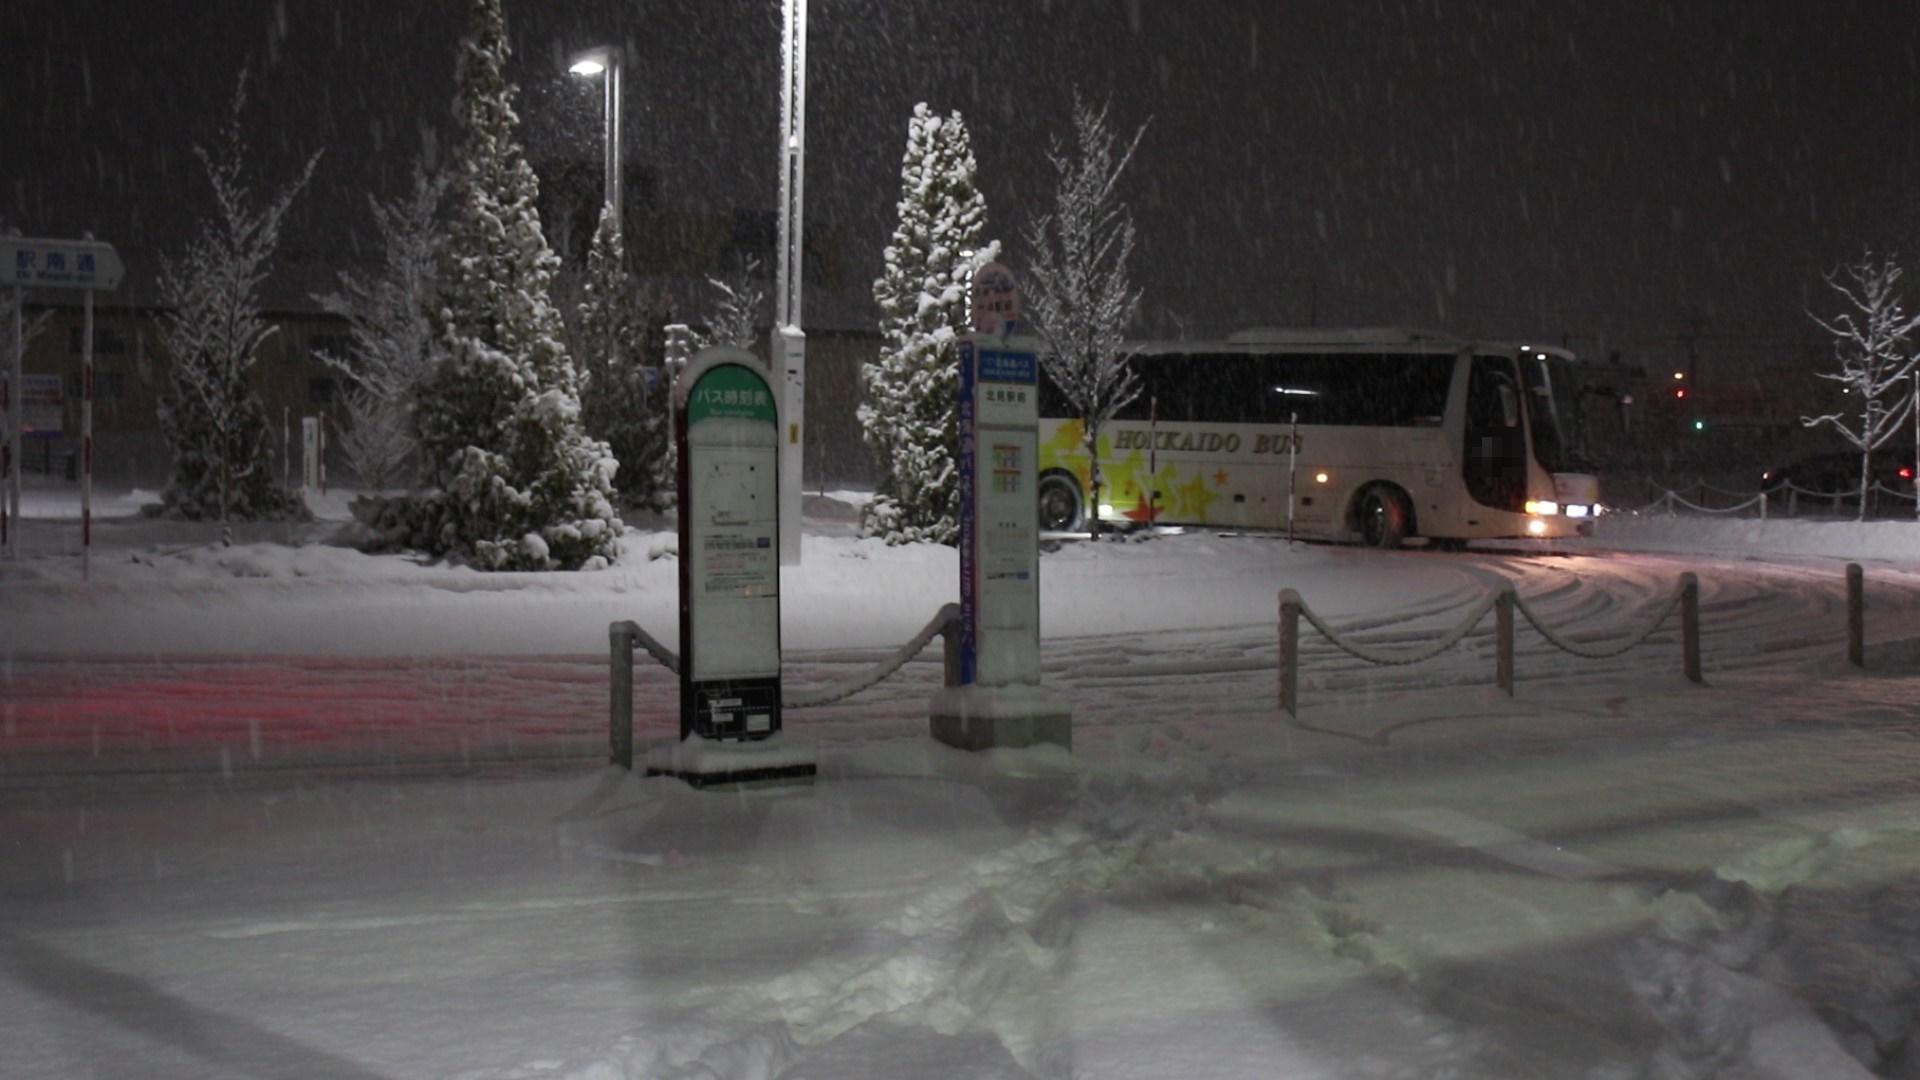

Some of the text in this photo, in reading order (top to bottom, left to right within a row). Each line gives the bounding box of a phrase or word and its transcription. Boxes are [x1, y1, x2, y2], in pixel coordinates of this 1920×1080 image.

[697, 388, 767, 406] バス時刻表
[1114, 430, 1304, 455] HOKKAIDO BUS
